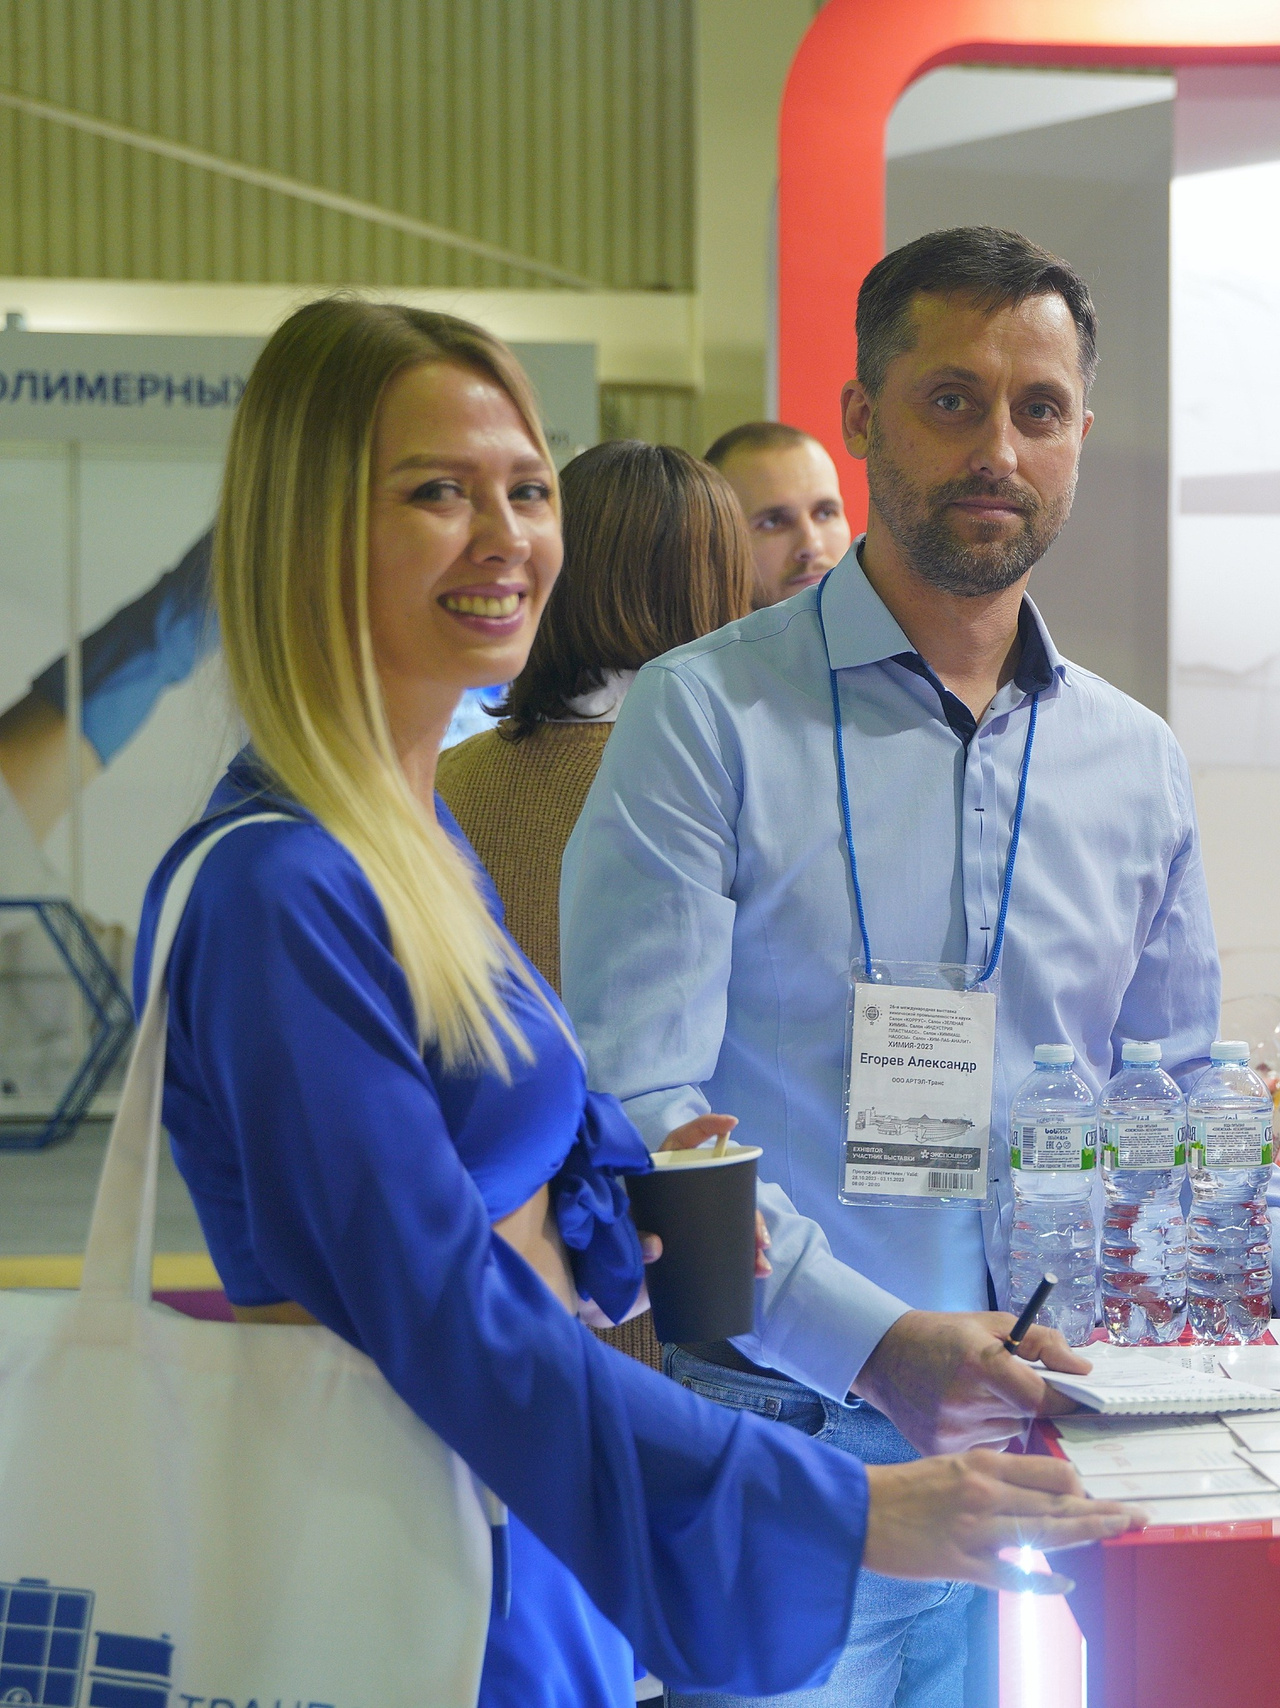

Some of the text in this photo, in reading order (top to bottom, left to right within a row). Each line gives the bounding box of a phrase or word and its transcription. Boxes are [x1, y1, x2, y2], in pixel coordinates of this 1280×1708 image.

[888, 1041, 934, 1051] ХИМИЯ-2023
[860, 1052, 977, 1073] Егорев Александр
[905, 1078, 945, 1087] АРТЭЛ-Транс
[883, 1154, 915, 1162] ВЫСТАВКИ
[930, 1151, 973, 1160] ЭКСПОЦЕНТР
